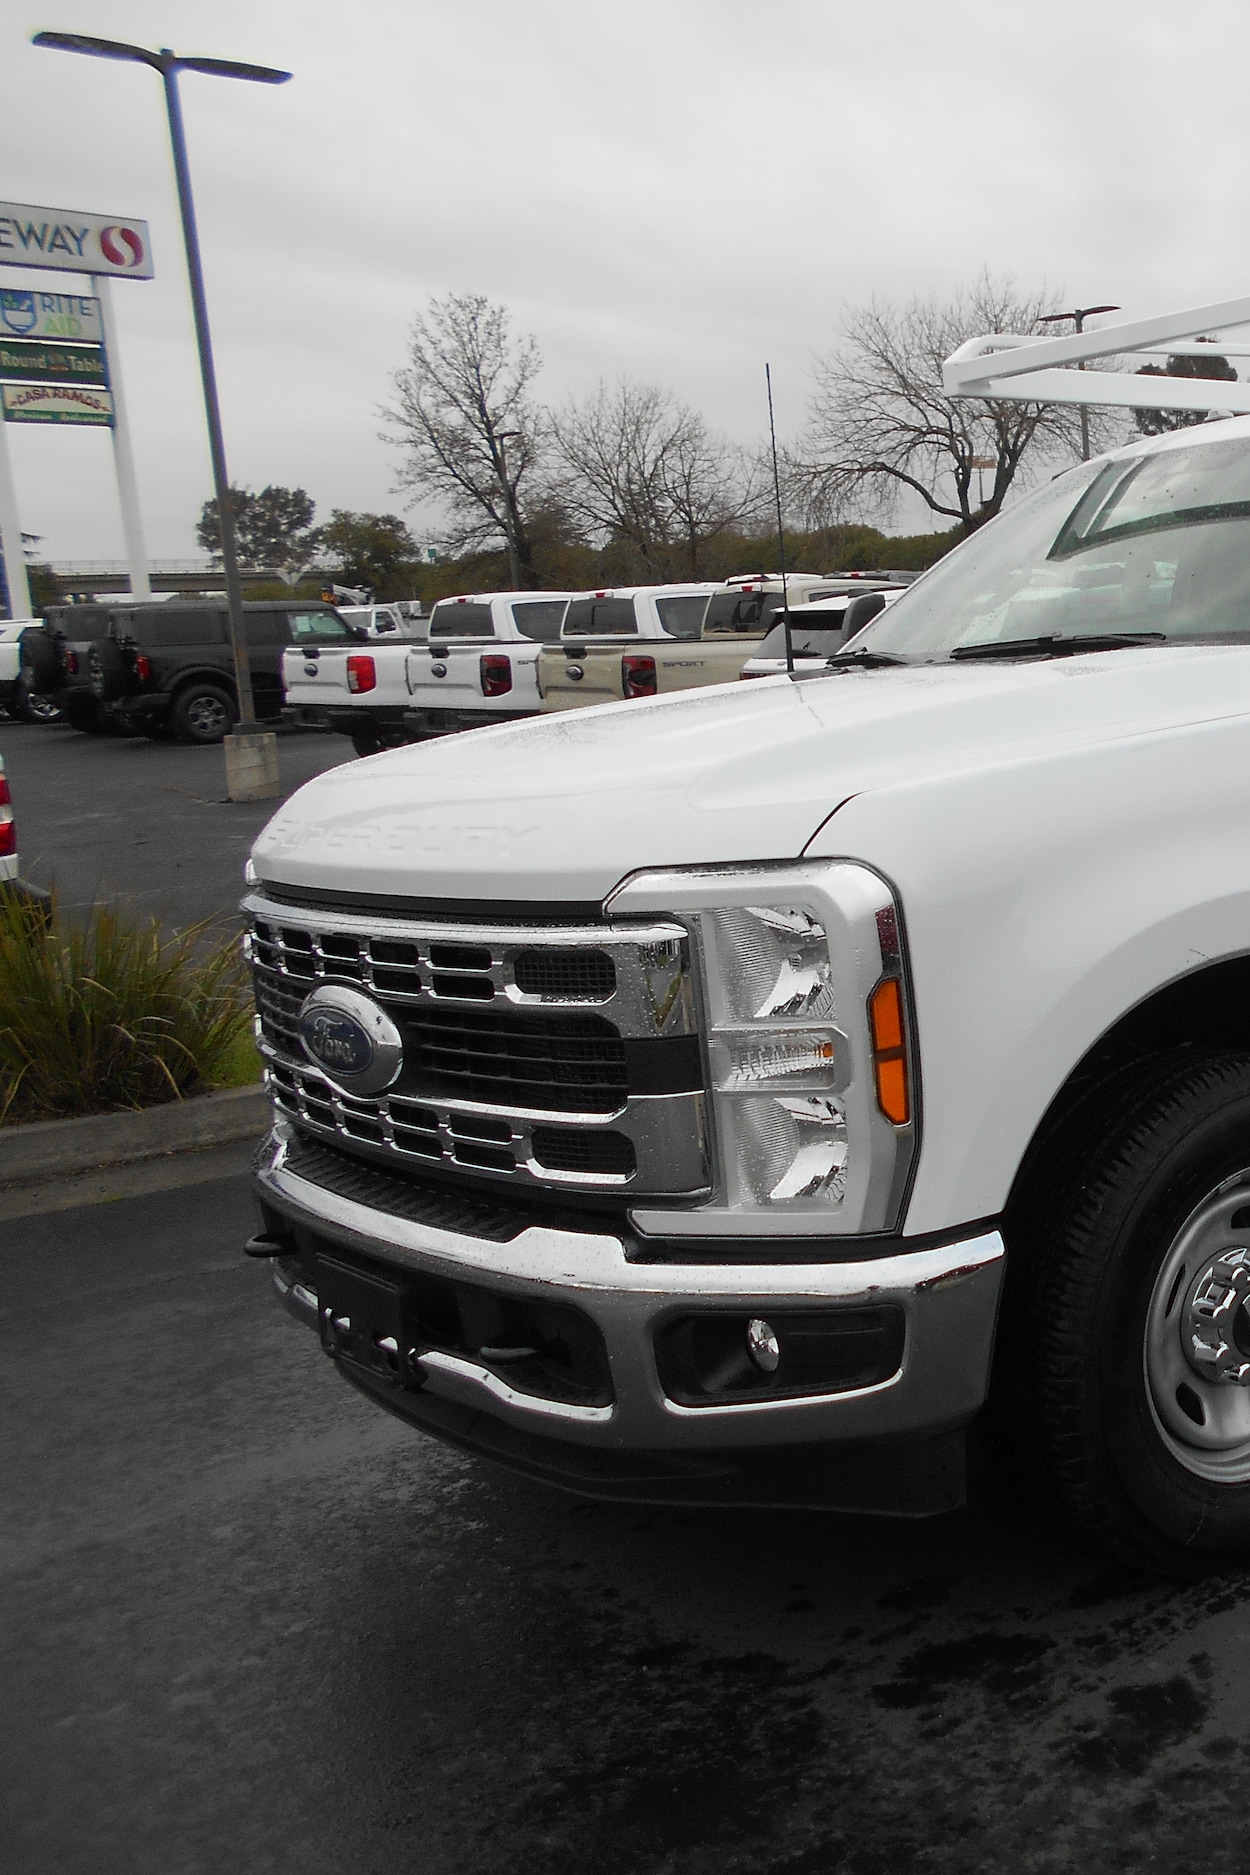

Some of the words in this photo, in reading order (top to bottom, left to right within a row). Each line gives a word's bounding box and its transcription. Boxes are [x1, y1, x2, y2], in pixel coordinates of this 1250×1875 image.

[41, 294, 93, 316] RITE
[45, 314, 82, 336] AID
[1, 350, 47, 369] Round
[67, 355, 104, 373] Table
